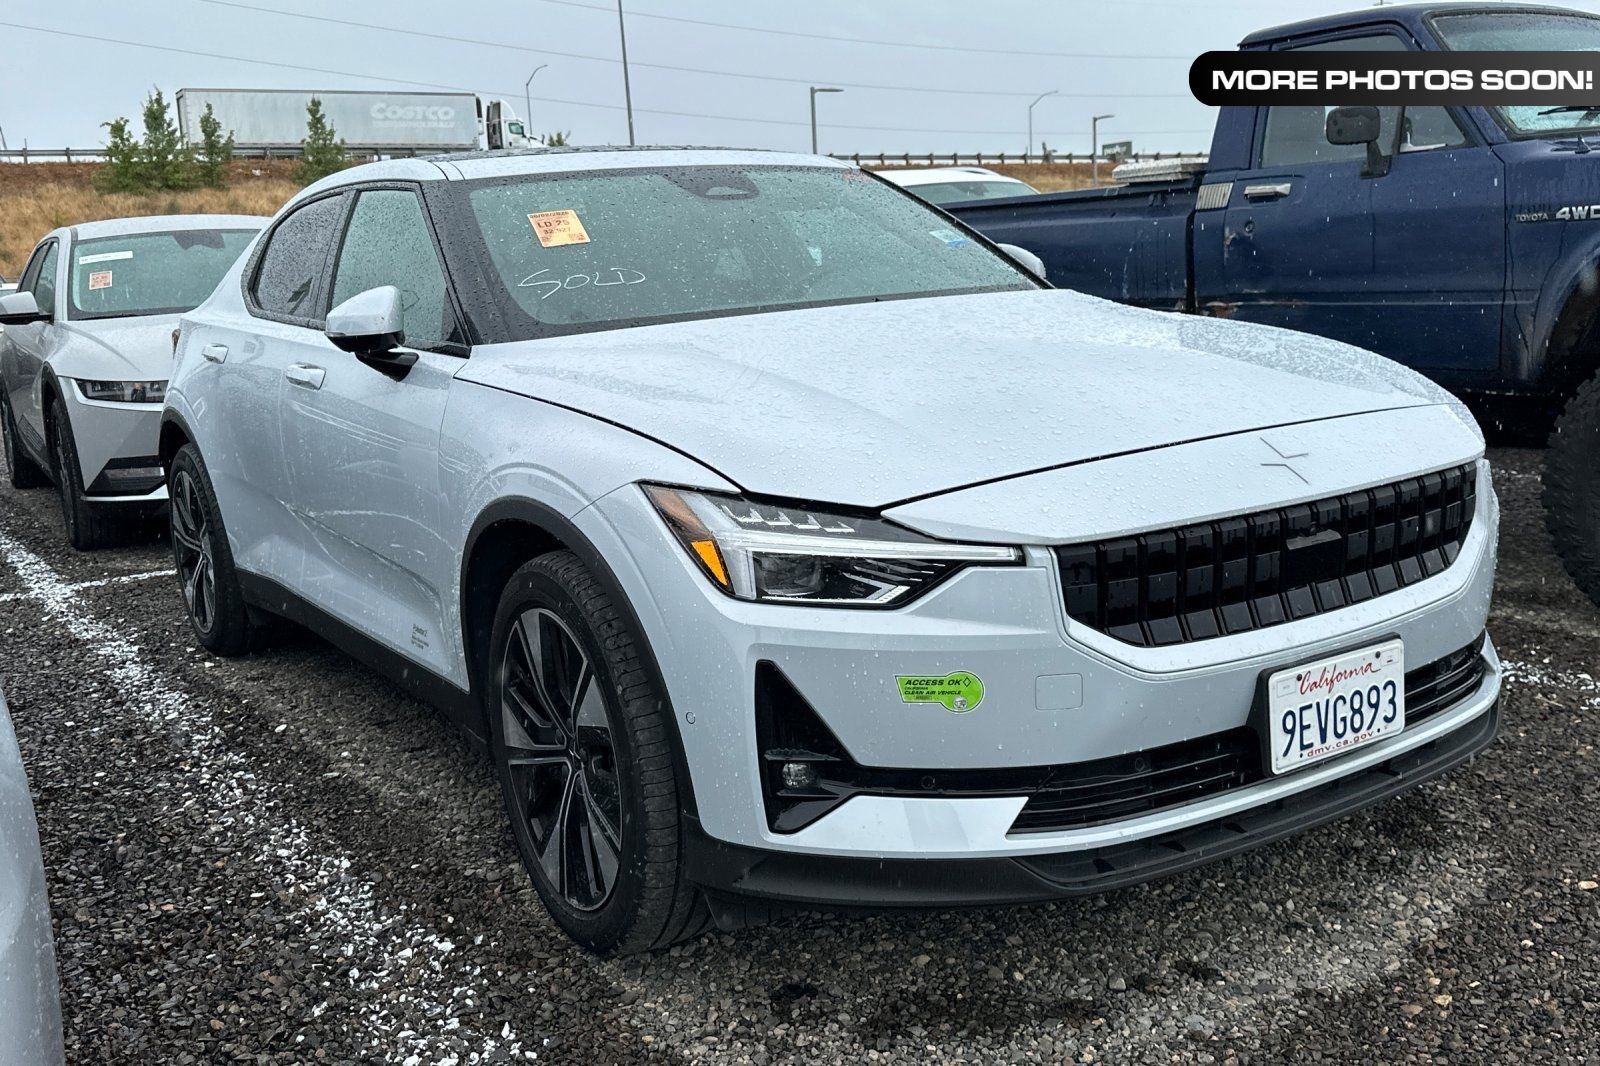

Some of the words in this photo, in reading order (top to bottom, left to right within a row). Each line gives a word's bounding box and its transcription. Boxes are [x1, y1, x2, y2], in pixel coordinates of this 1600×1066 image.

[1515, 213, 1549, 221] TOYOTA
[517, 267, 646, 300] SOLD
[1299, 657, 1382, 696] California
[1281, 679, 1397, 758] 9EVG893
[1306, 730, 1375, 758] dmv.ca.gov
